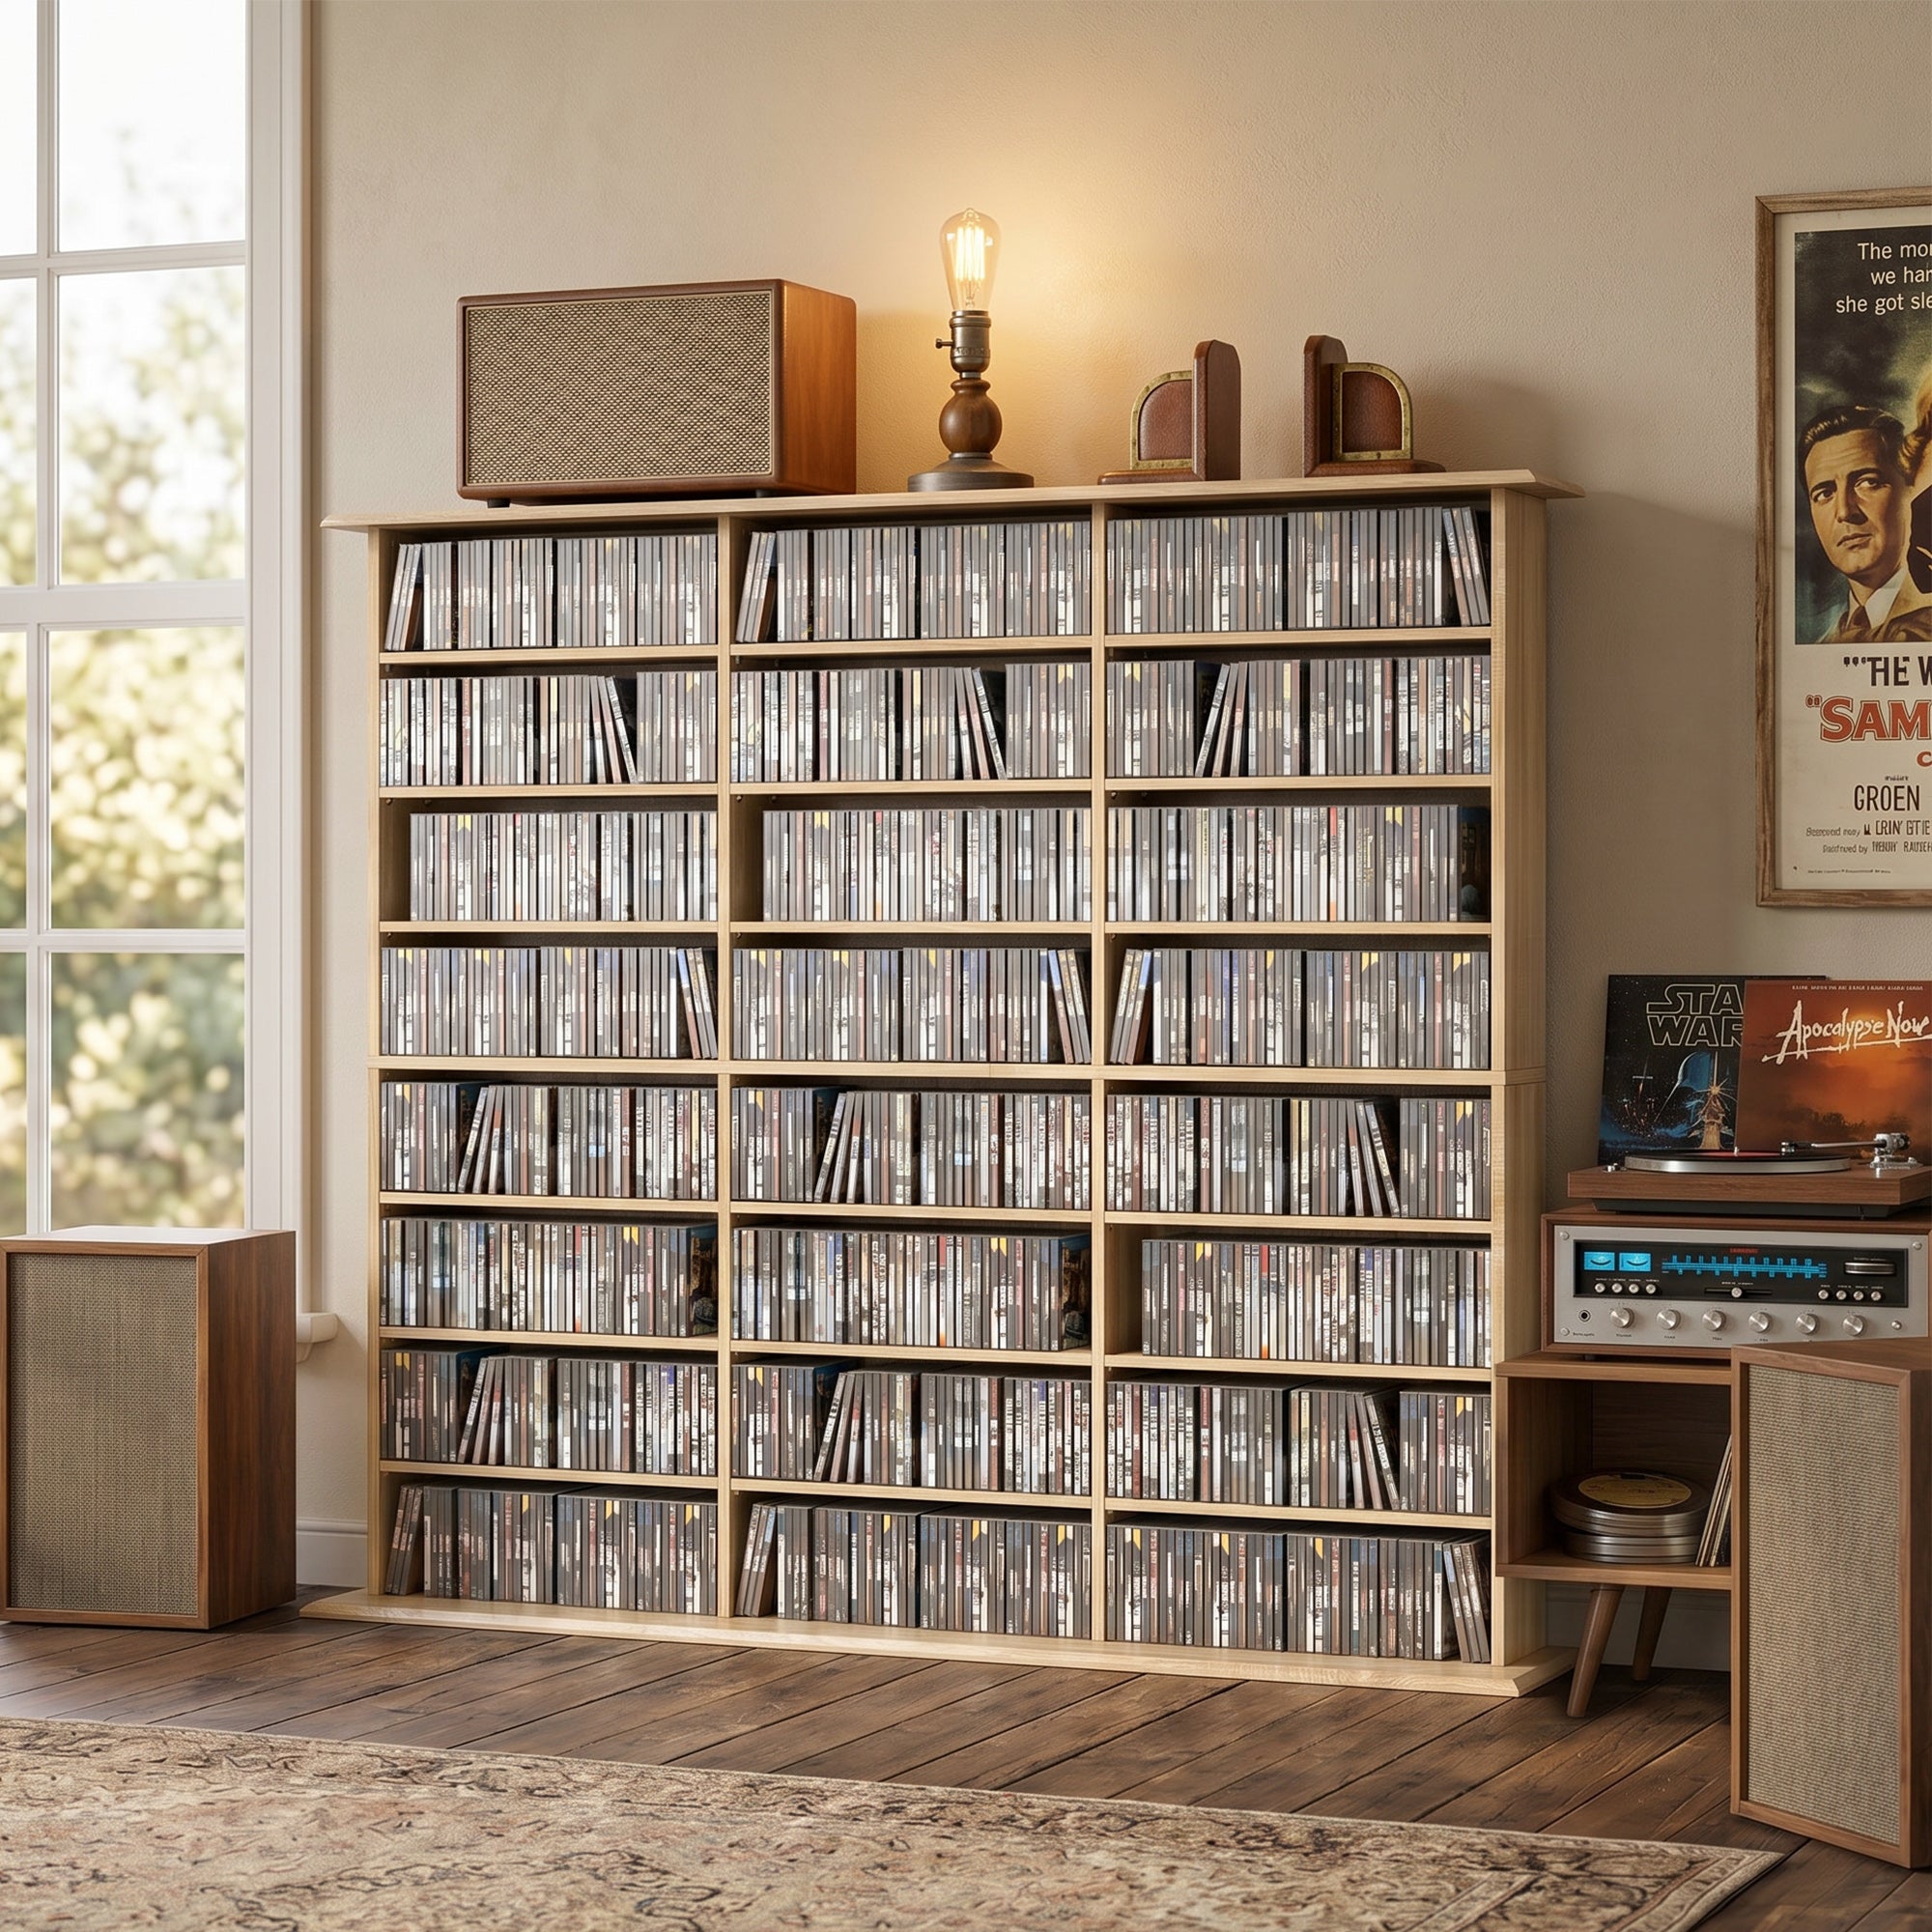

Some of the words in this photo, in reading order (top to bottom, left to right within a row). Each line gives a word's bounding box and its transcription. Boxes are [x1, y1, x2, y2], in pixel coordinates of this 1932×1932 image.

[1857, 242, 1892, 261] The
[1900, 242, 1932, 259] mo
[1870, 270, 1896, 286] we
[1835, 295, 1868, 314] she
[1875, 293, 1905, 316] got
[1854, 784, 1919, 811] GROEN
[1776, 1000, 1884, 1065] Apocalypse
[1886, 1000, 1930, 1048] Now
